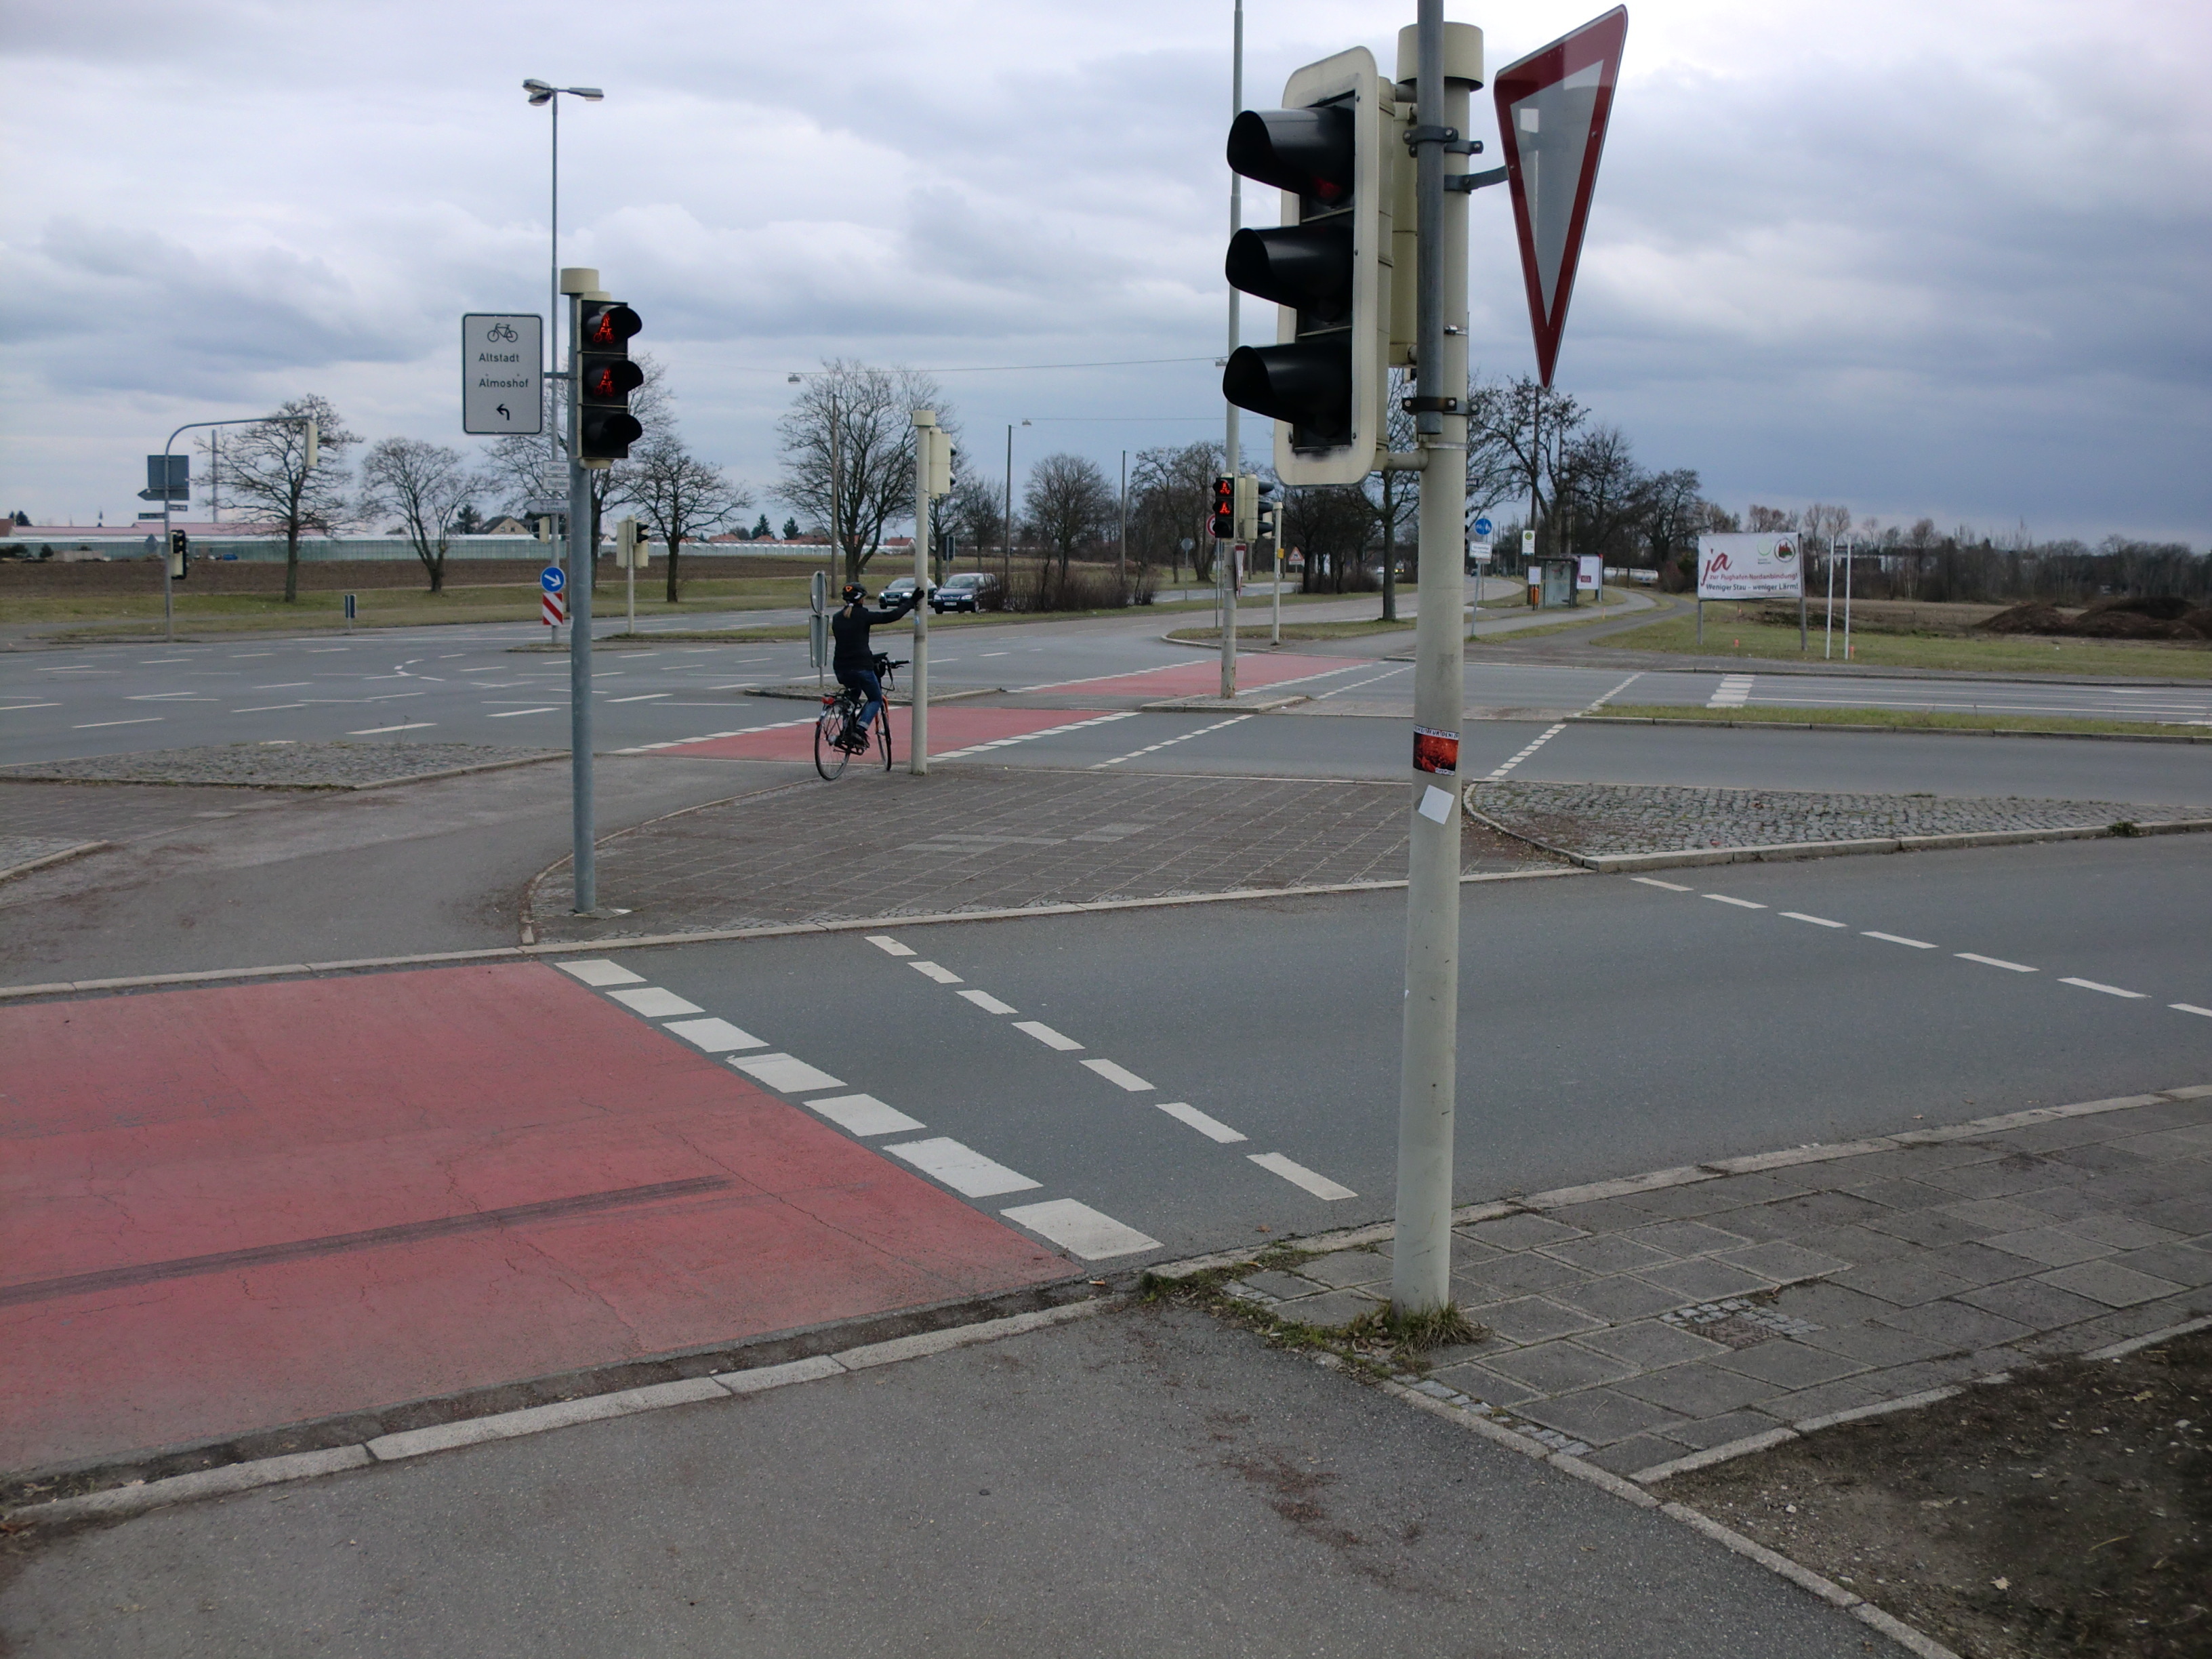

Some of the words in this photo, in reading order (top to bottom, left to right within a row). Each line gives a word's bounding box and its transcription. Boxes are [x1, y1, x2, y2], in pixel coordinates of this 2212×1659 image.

[478, 352, 520, 363] Altstadt
[478, 377, 529, 388] Almoshof
[1700, 548, 1733, 586] ja
[1753, 583, 1777, 592] weniger
